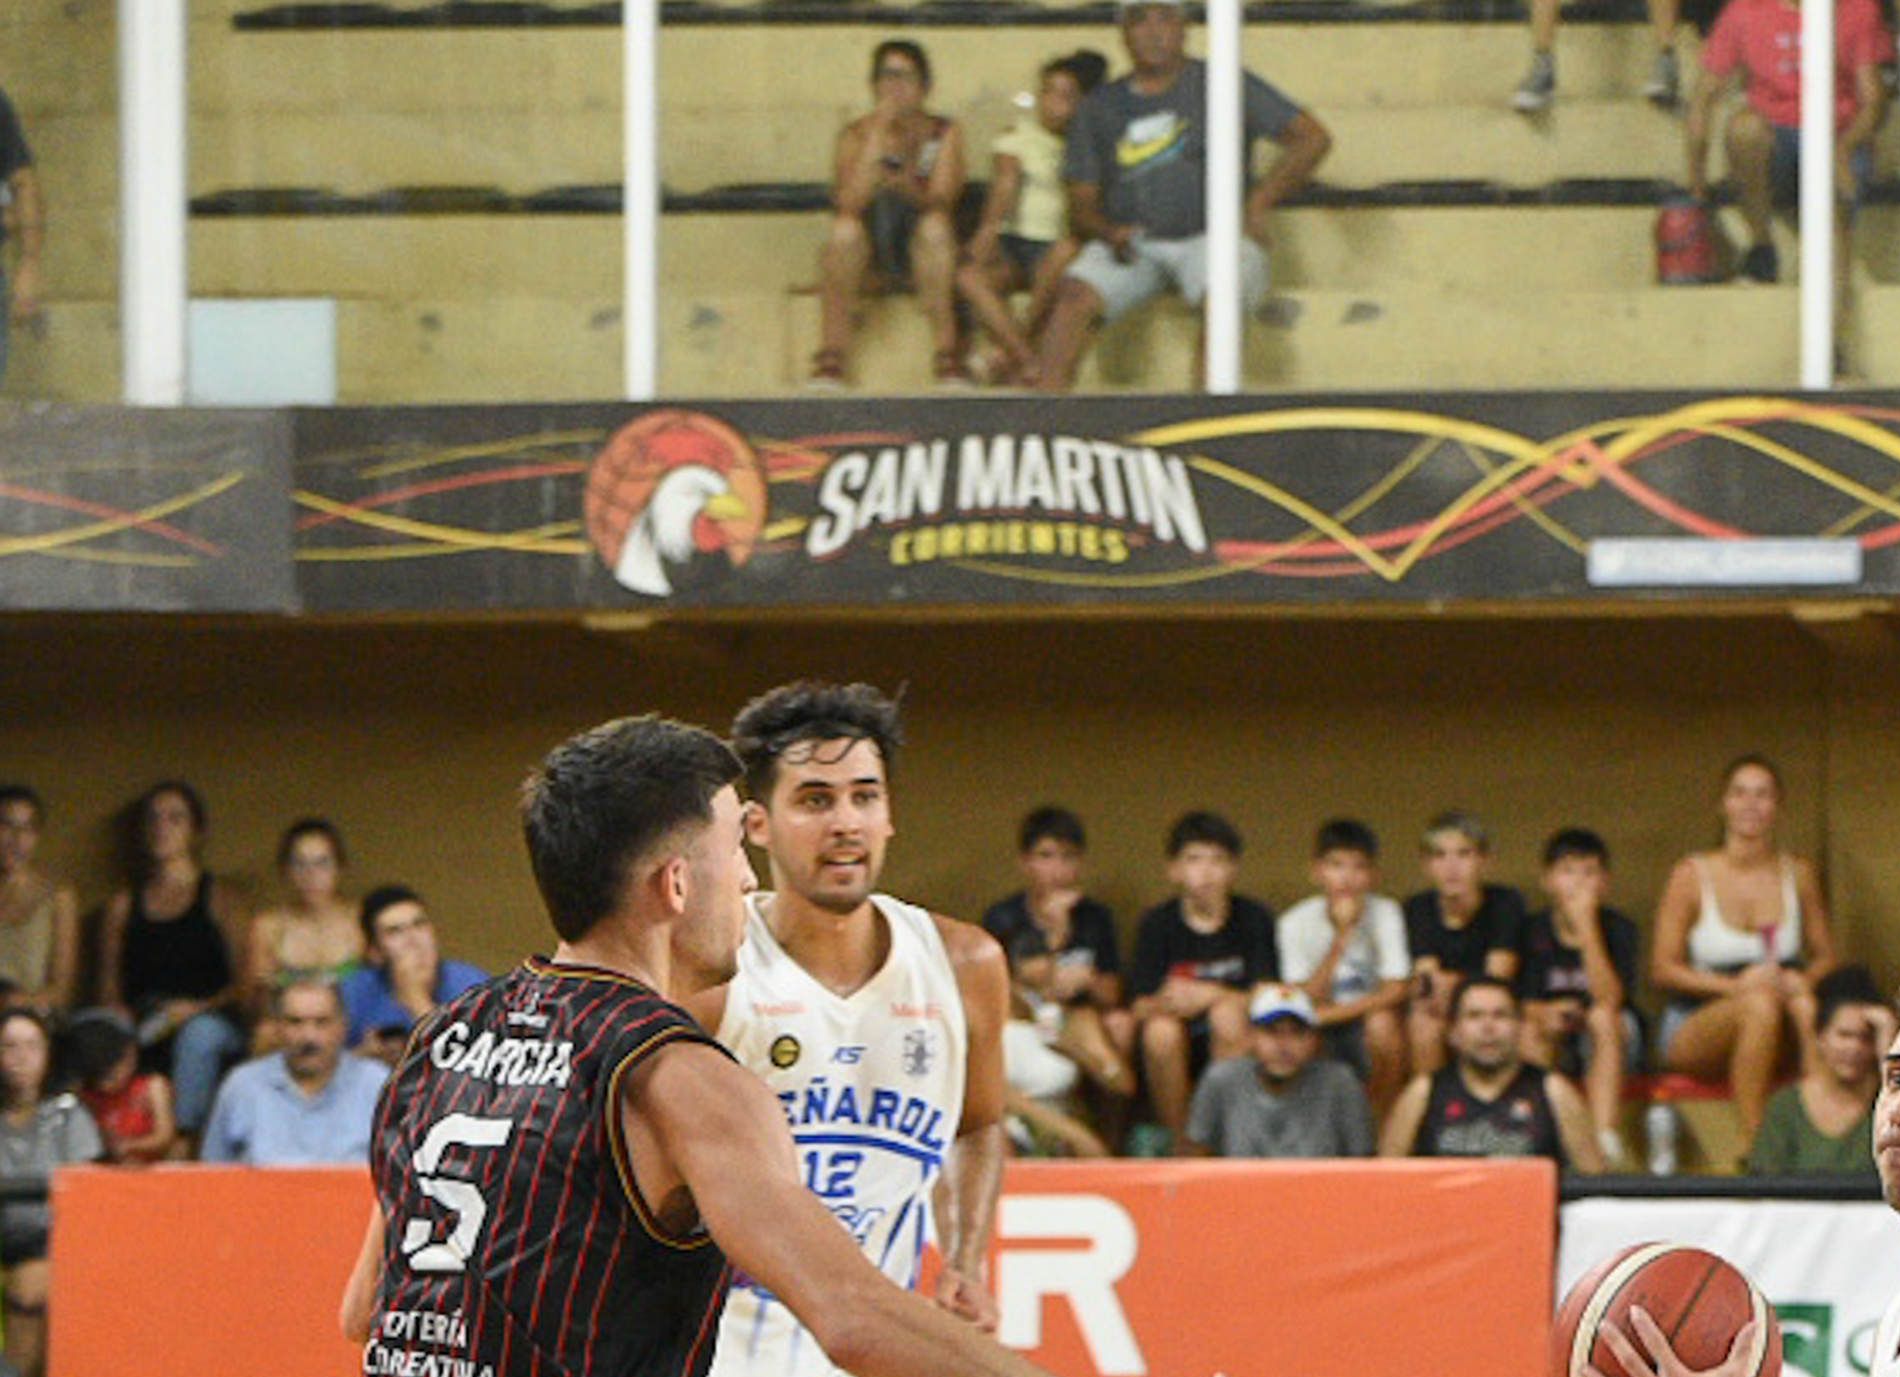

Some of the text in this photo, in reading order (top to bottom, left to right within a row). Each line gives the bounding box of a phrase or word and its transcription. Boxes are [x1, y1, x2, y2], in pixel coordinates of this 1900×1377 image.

[806, 433, 1208, 558] SAN MARTIN
[889, 519, 1130, 566] CORRIENTES
[430, 1020, 574, 1088] GARCIA
[776, 1076, 944, 1151] EÑAROL
[402, 1113, 513, 1272] 5
[805, 1150, 865, 1198] 12
